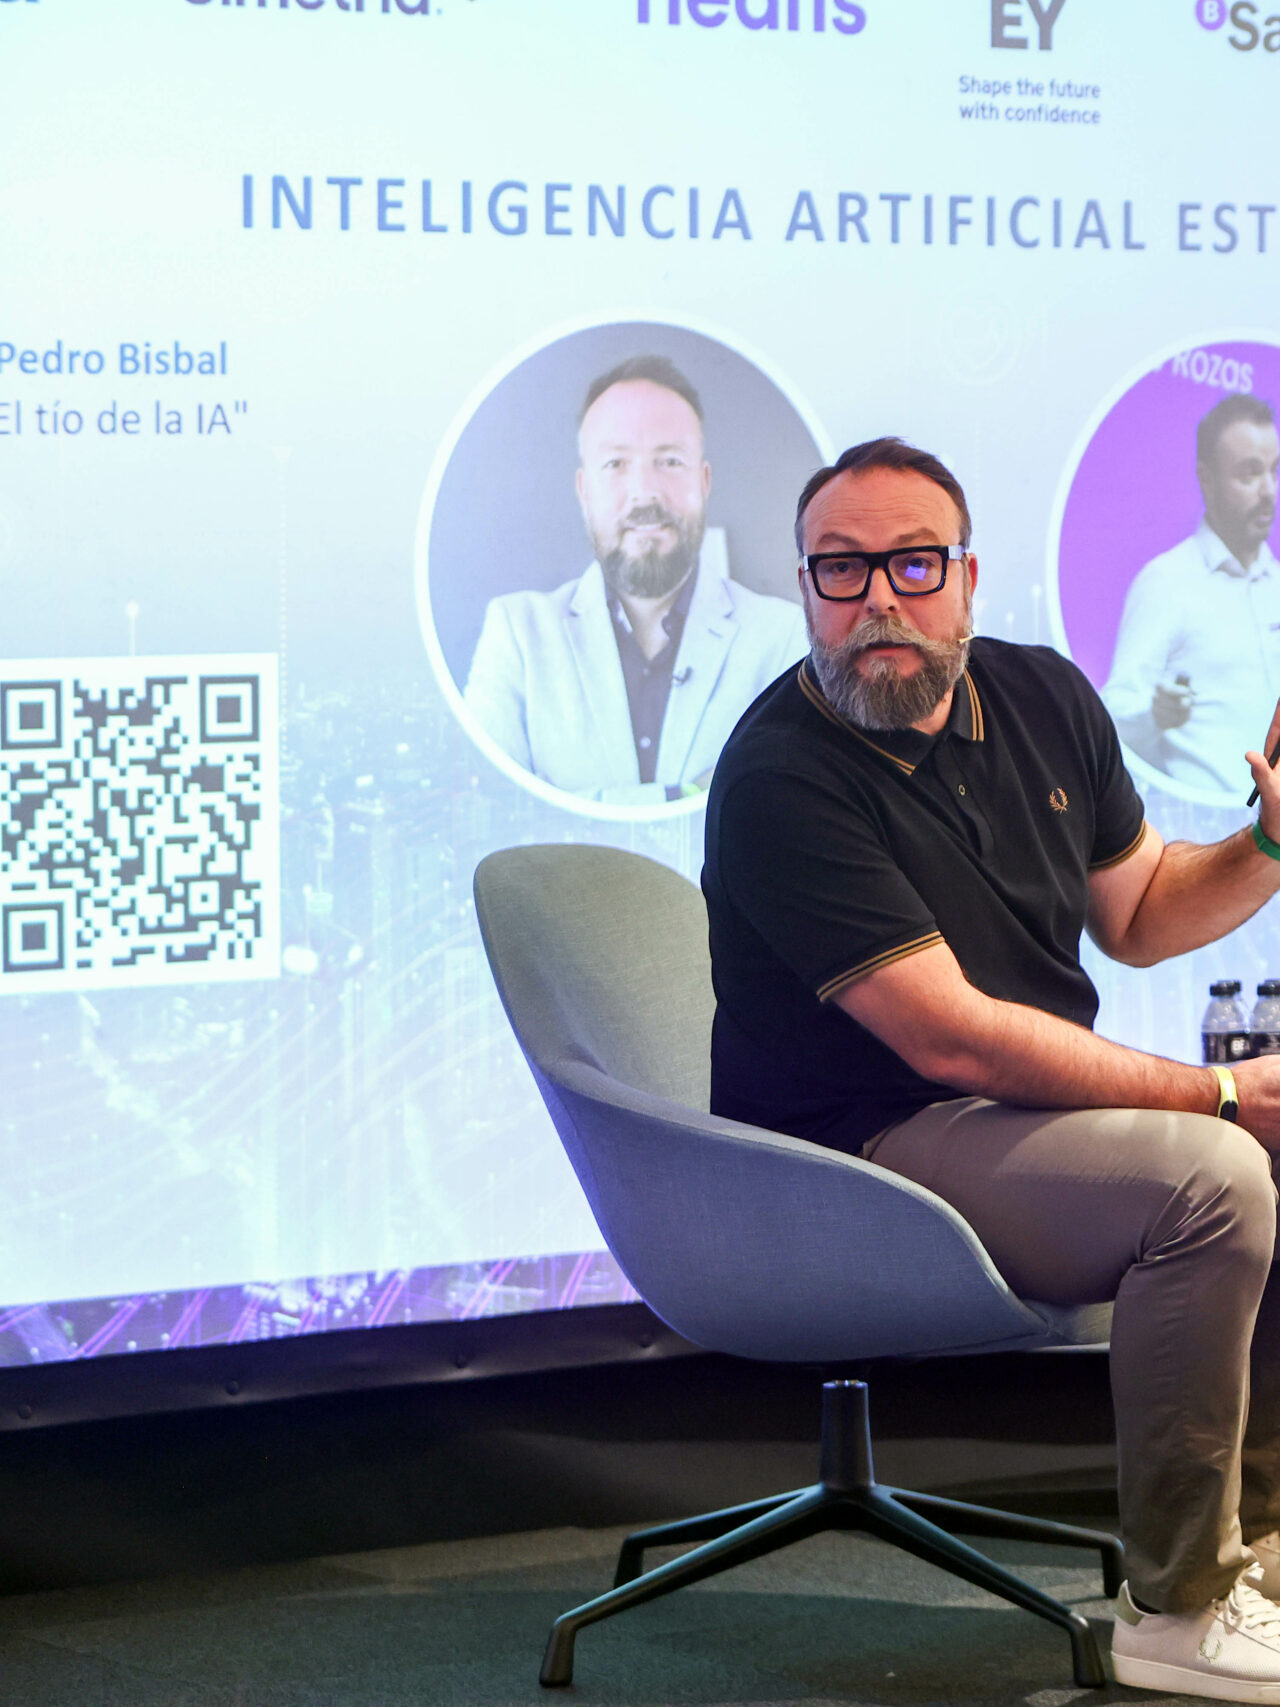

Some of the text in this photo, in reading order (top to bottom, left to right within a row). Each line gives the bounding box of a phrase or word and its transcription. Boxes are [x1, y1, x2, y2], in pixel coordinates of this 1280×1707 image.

[991, 0, 1066, 51] EY
[958, 74, 1102, 99] Shape the future
[959, 101, 1102, 124] with confidence
[241, 174, 753, 241] INTELIGENCIA
[785, 190, 1145, 251] ARTIFICIAL
[0, 340, 227, 375] Pedro Bisbal
[35, 400, 84, 435] tío
[97, 400, 141, 435] de
[155, 400, 183, 435] la
[198, 400, 248, 435] IA"
